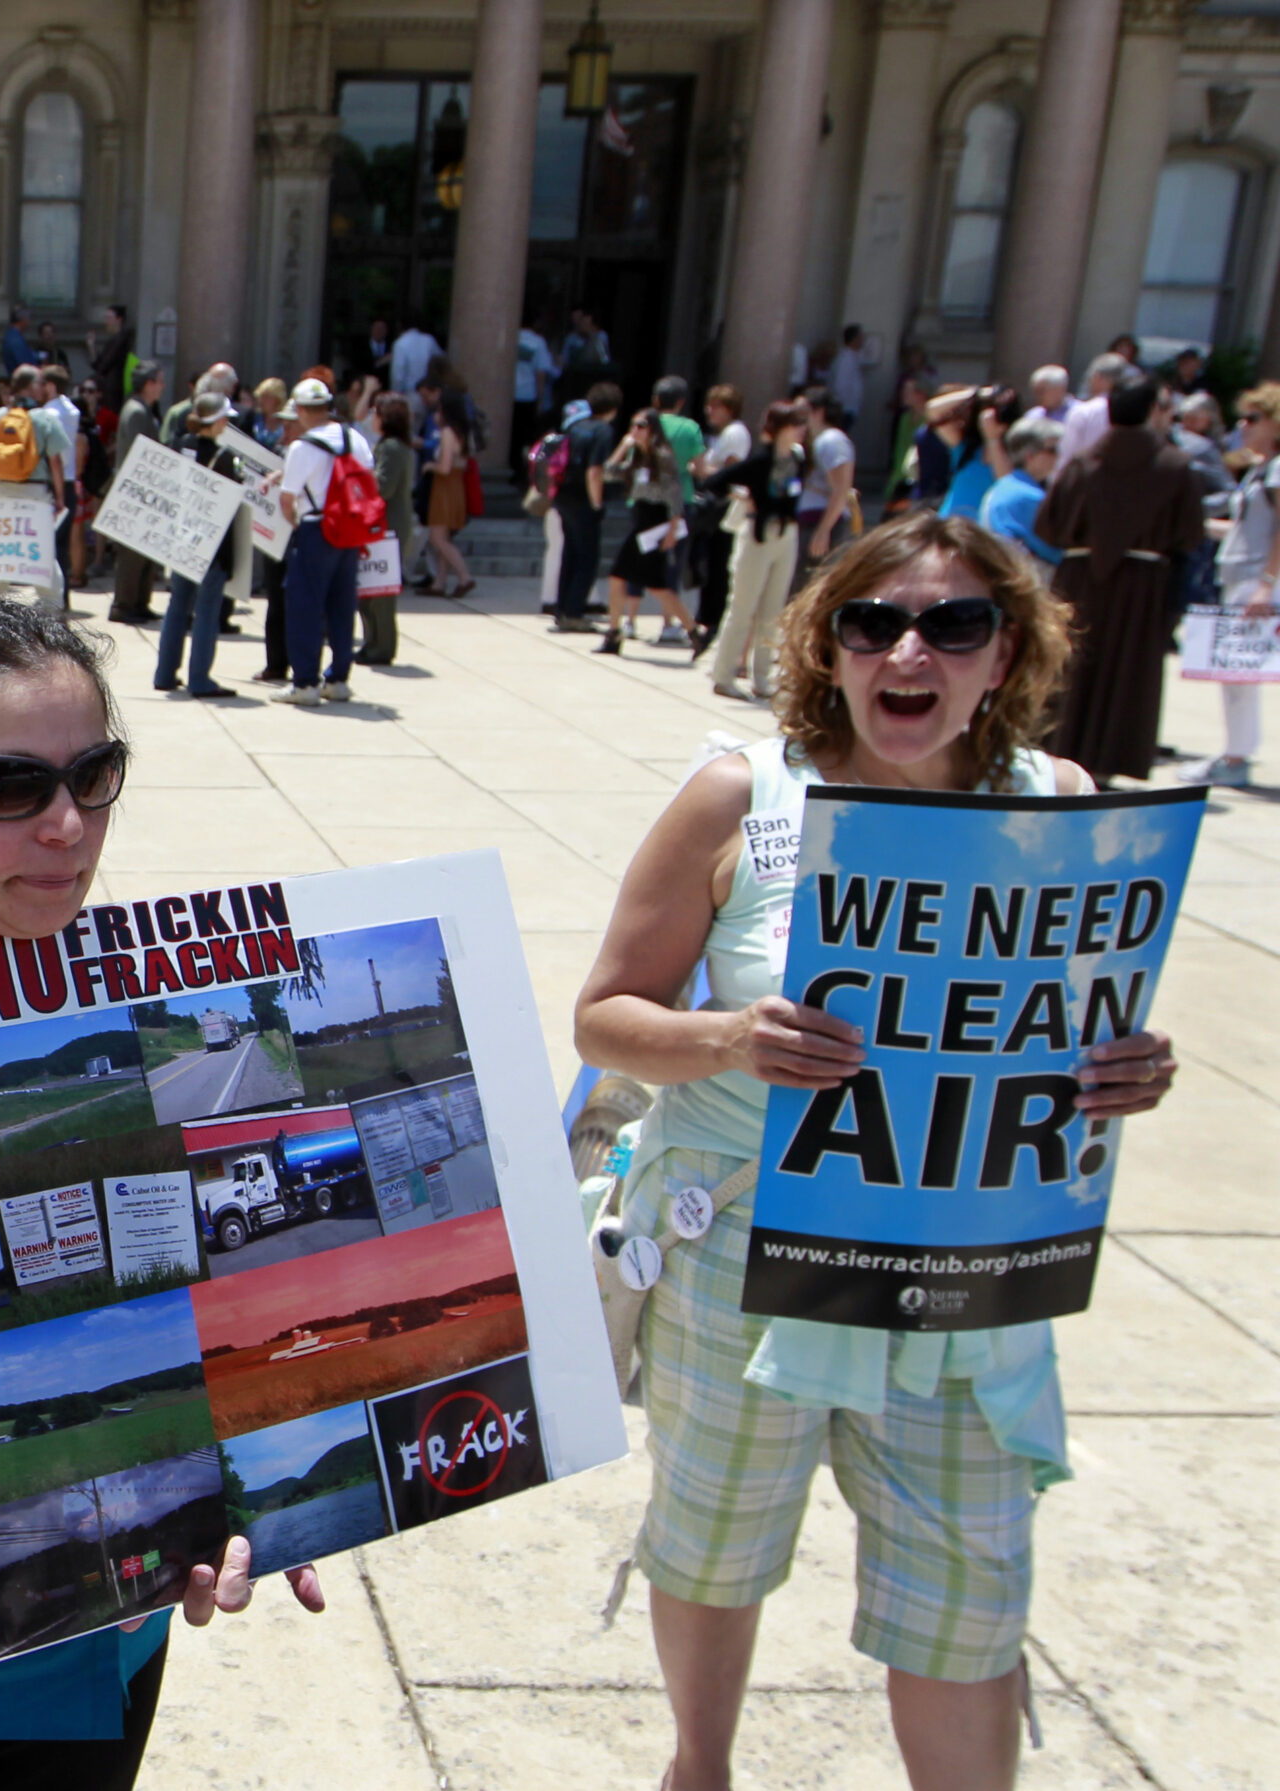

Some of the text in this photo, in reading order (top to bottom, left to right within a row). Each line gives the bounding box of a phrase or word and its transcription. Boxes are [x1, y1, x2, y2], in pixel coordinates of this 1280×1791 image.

[140, 450, 180, 471] KEEP
[118, 478, 180, 518] FRACKING
[118, 500, 143, 517] OUT
[146, 512, 161, 527] OF
[99, 509, 137, 537] PASS
[745, 817, 791, 836] Ban
[60, 881, 291, 959] FRICKIN
[816, 871, 1168, 960] WE NEED
[69, 926, 301, 1008] FRACKIN
[802, 967, 1149, 1055] CLEAN
[12, 1239, 55, 1258] WARNING
[58, 1231, 99, 1250] WARNING
[762, 1239, 1093, 1277] www.sierraclub.org/asthma
[395, 1407, 531, 1481] FRACK
